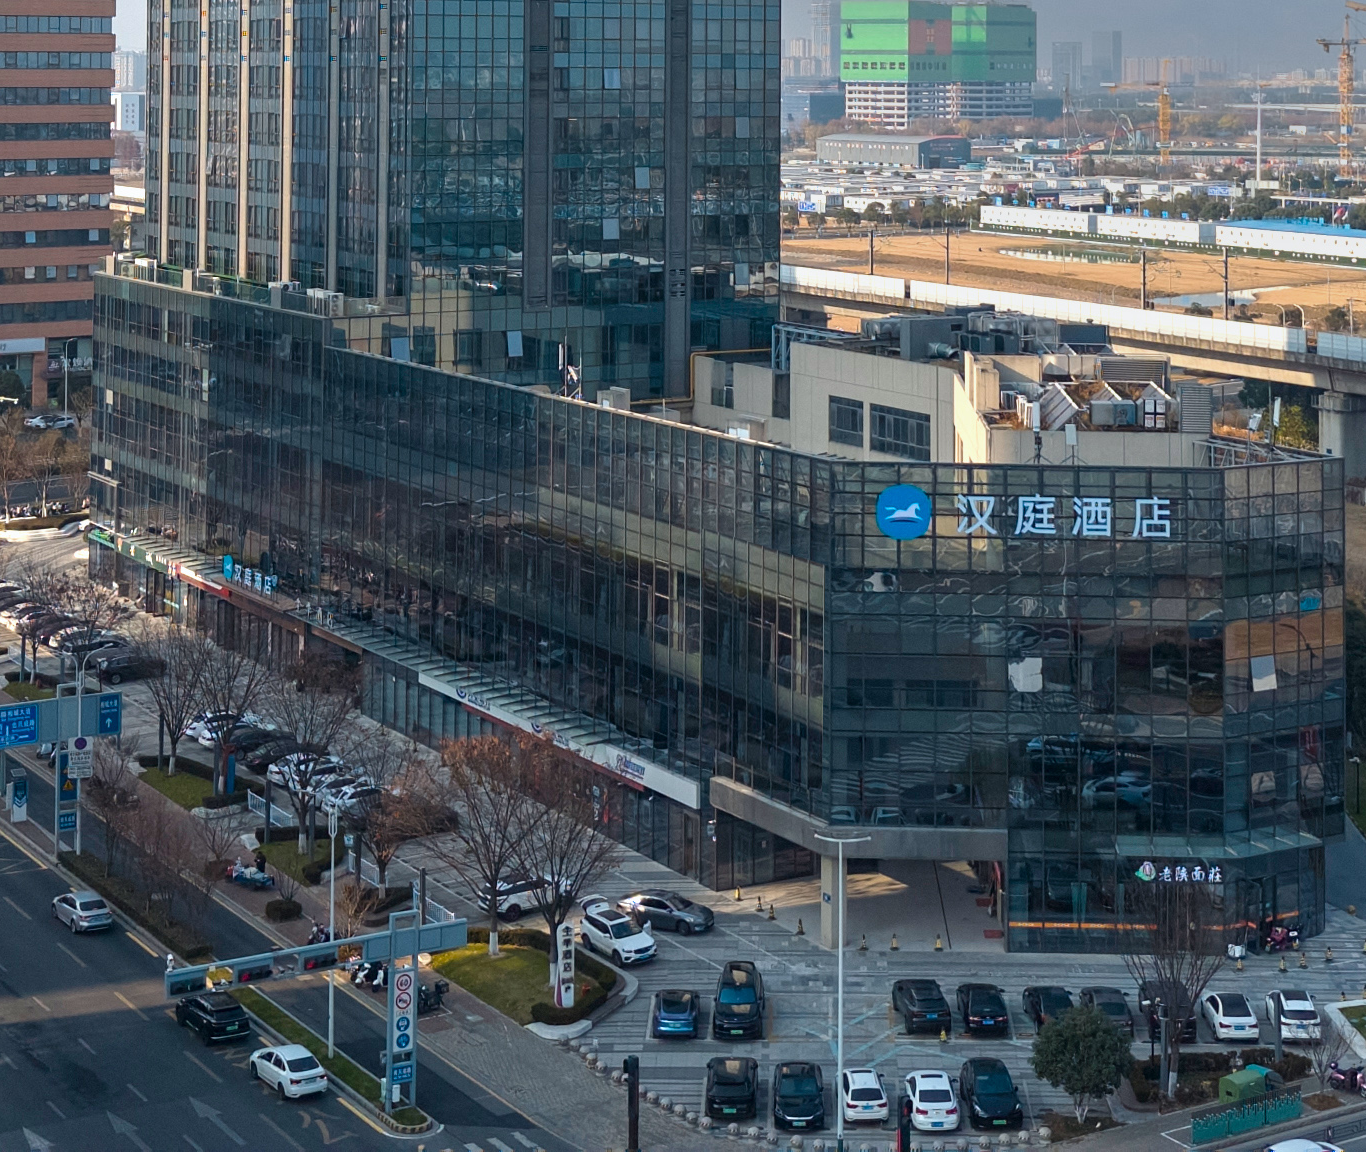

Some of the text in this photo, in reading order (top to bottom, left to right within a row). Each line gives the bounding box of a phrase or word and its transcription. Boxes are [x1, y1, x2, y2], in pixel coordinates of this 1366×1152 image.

[957, 494, 1171, 538] 汉庭酒店
[235, 564, 271, 595] 汉庭酒店
[399, 978, 410, 987] 60
